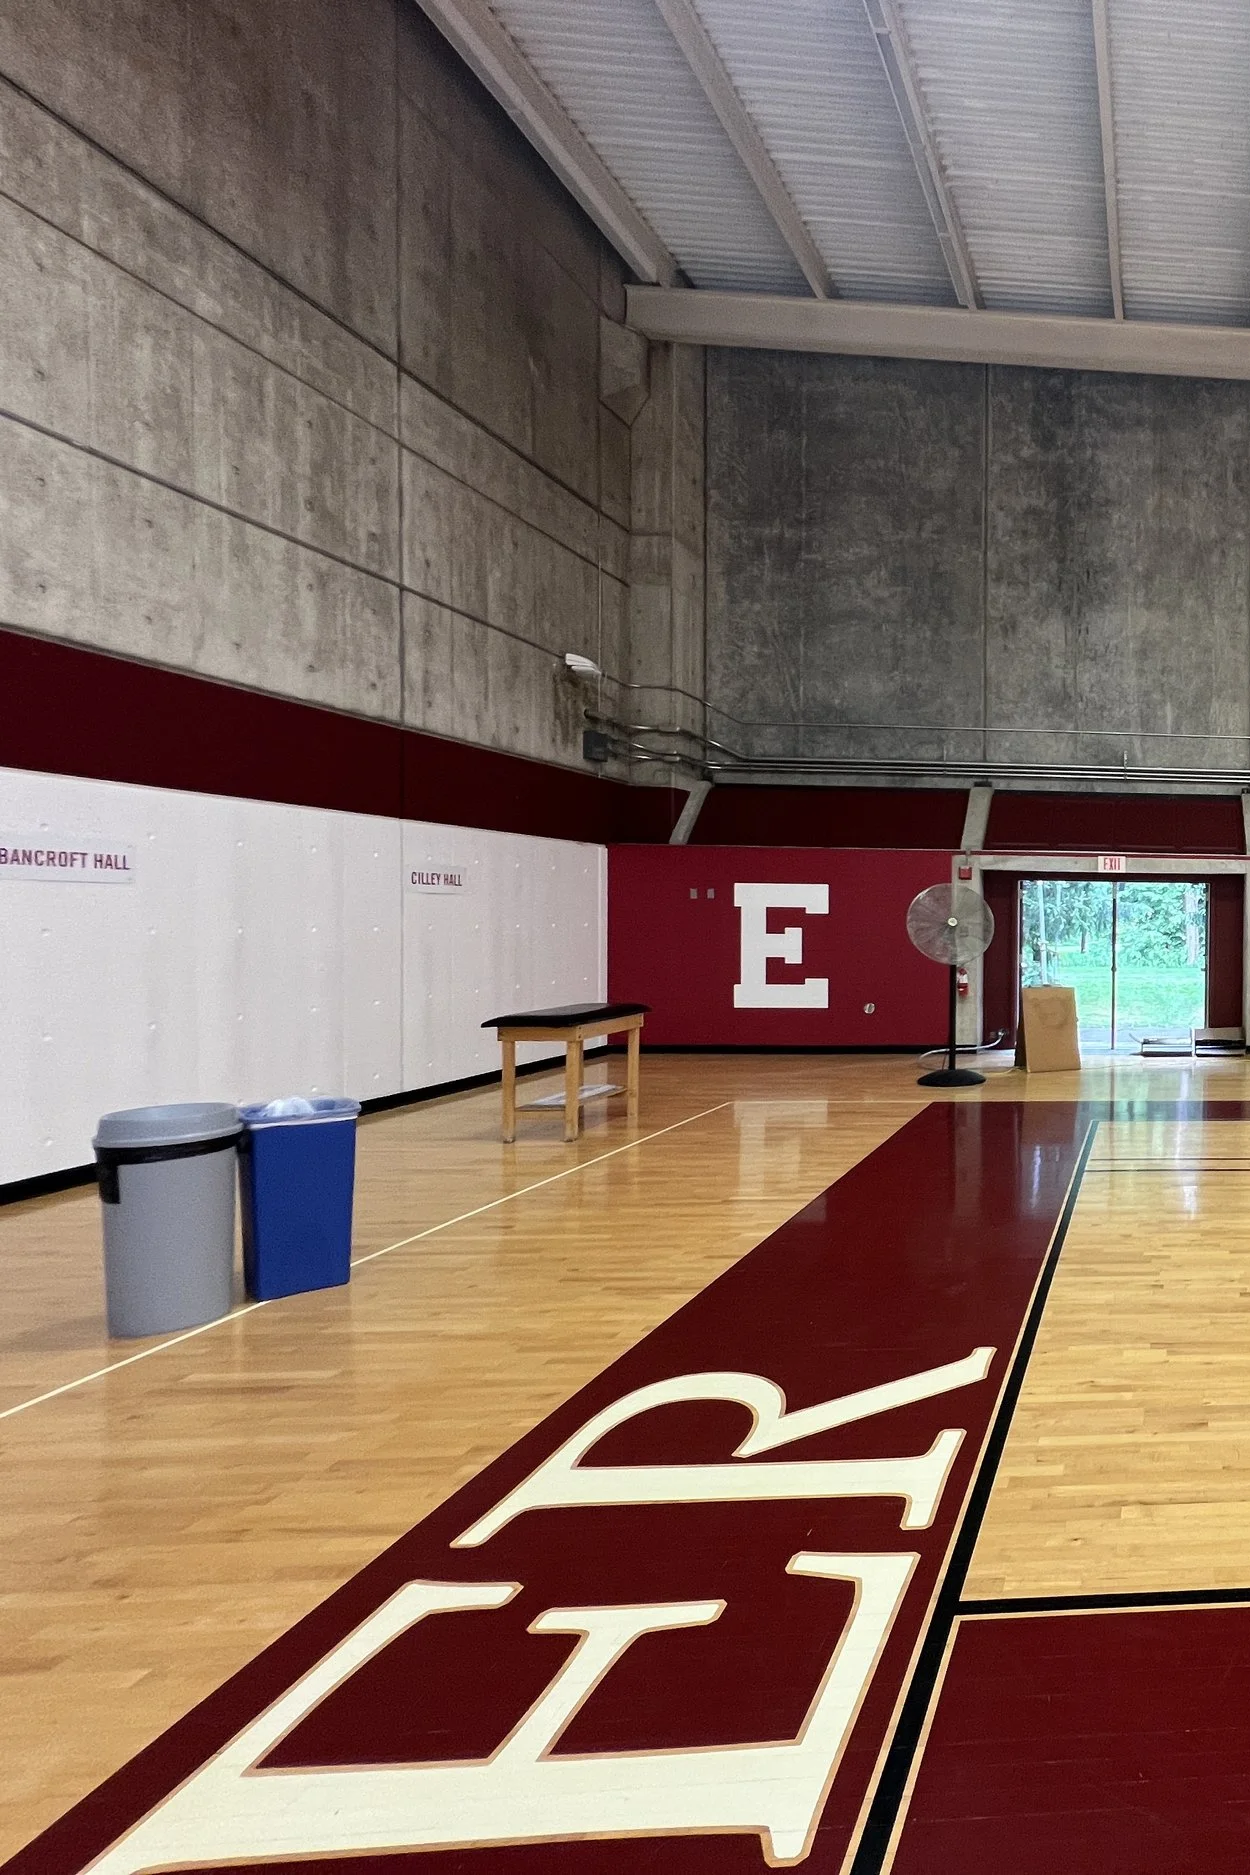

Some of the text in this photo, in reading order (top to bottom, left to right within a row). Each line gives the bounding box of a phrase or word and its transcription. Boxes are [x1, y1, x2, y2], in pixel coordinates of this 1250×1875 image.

[0, 848, 131, 870] BANCROFT HALL
[1103, 857, 1121, 870] EXIT
[411, 871, 462, 887] CILLEY HALL
[733, 882, 829, 1009] E
